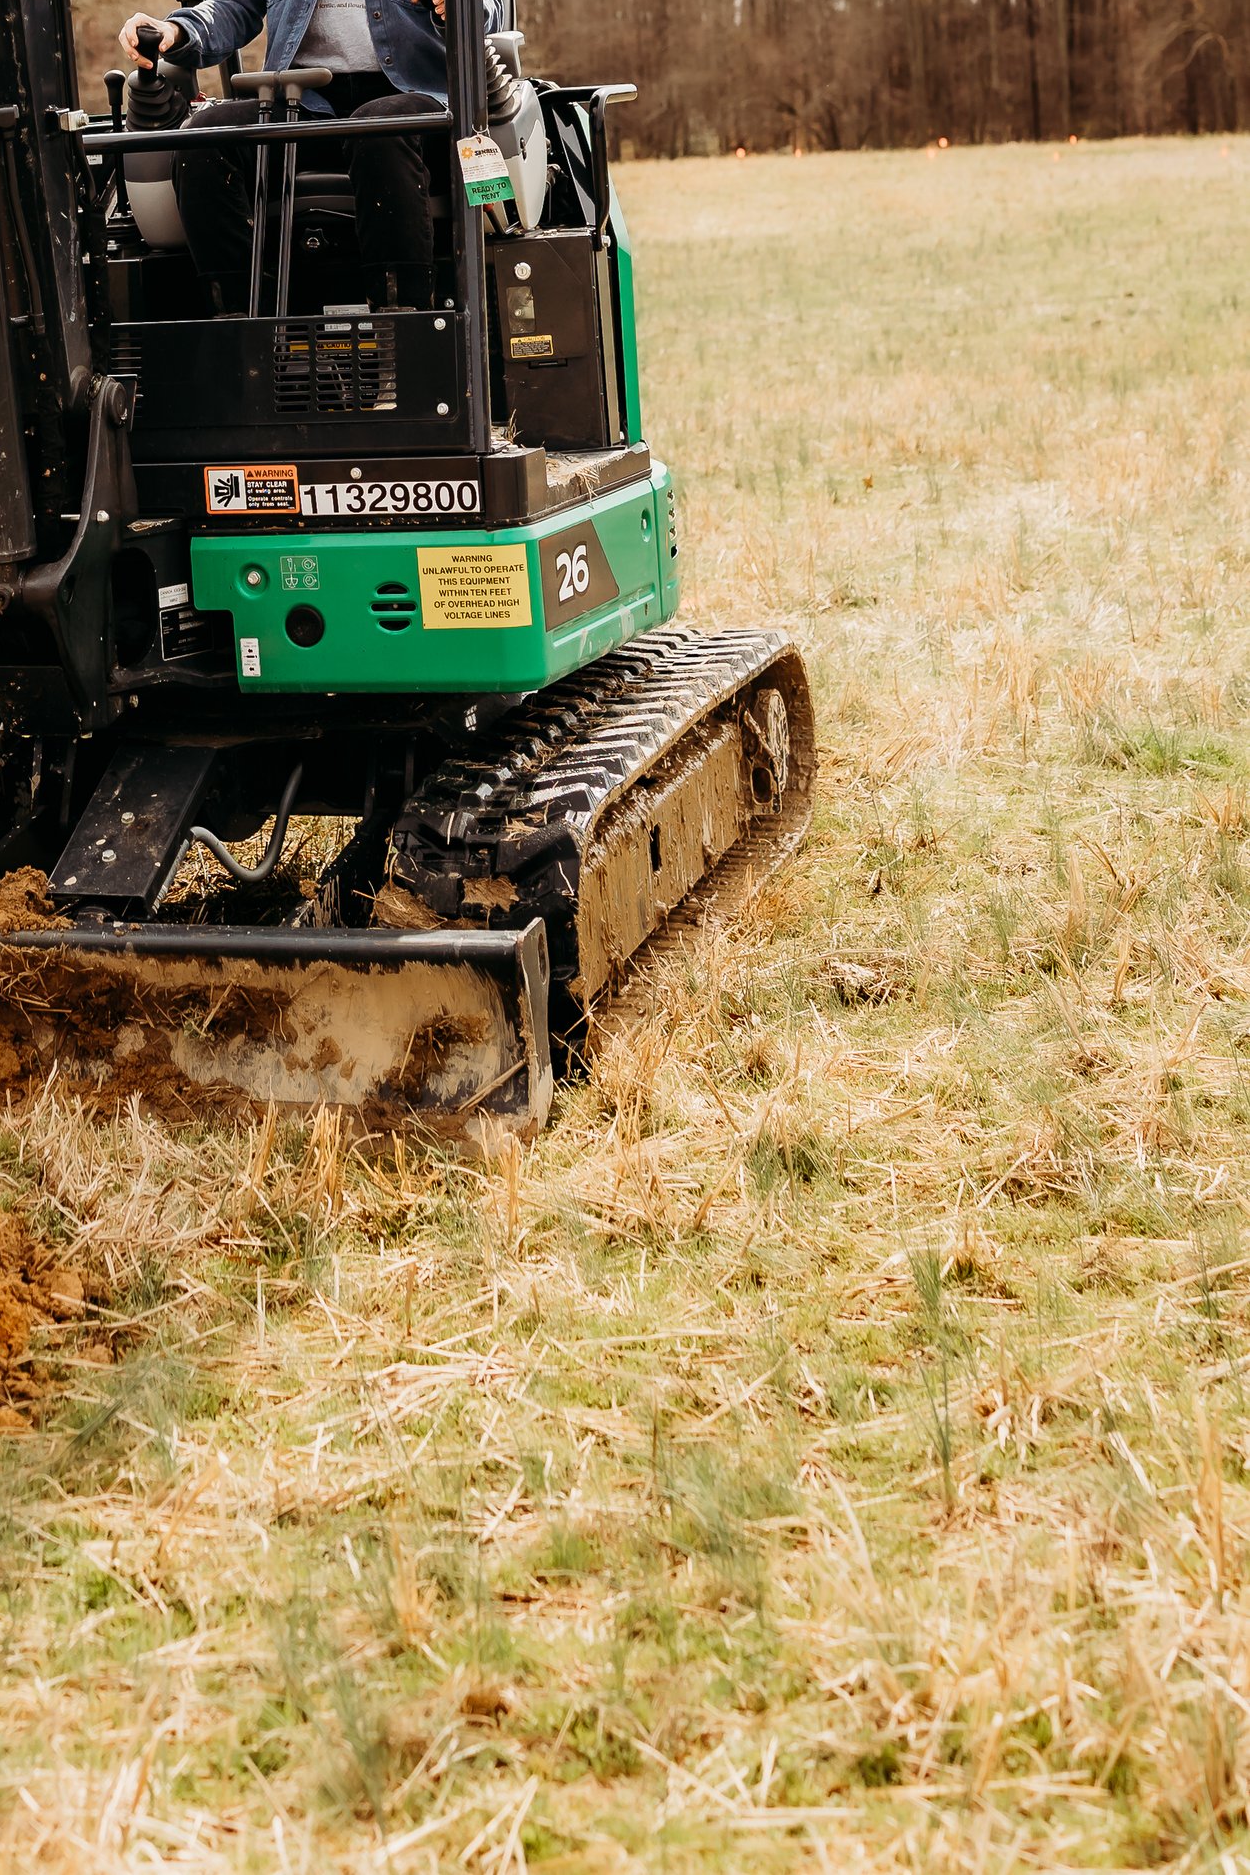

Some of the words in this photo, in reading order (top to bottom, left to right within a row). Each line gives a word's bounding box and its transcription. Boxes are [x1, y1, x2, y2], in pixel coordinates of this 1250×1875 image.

[471, 184, 495, 194] READY
[497, 181, 507, 189] TO
[481, 191, 500, 201] RENT
[254, 469, 294, 477] WARNING
[303, 482, 478, 514] 11329800
[451, 554, 493, 563] WARNING
[422, 566, 469, 575] UNLAWFUL
[470, 565, 481, 574] TO
[483, 563, 525, 573] OPERATE
[556, 543, 590, 602] 26
[438, 577, 458, 586] THIS
[459, 576, 511, 585] EQUIPMENT
[438, 588, 469, 597] WITHIN
[470, 588, 487, 596] TEN
[489, 587, 512, 596] FEET
[433, 600, 446, 609] OF
[447, 599, 496, 608] OVERHEAD
[497, 598, 520, 607] HIGH
[444, 611, 483, 620] VOLTAGE
[484, 610, 511, 619] LINES
